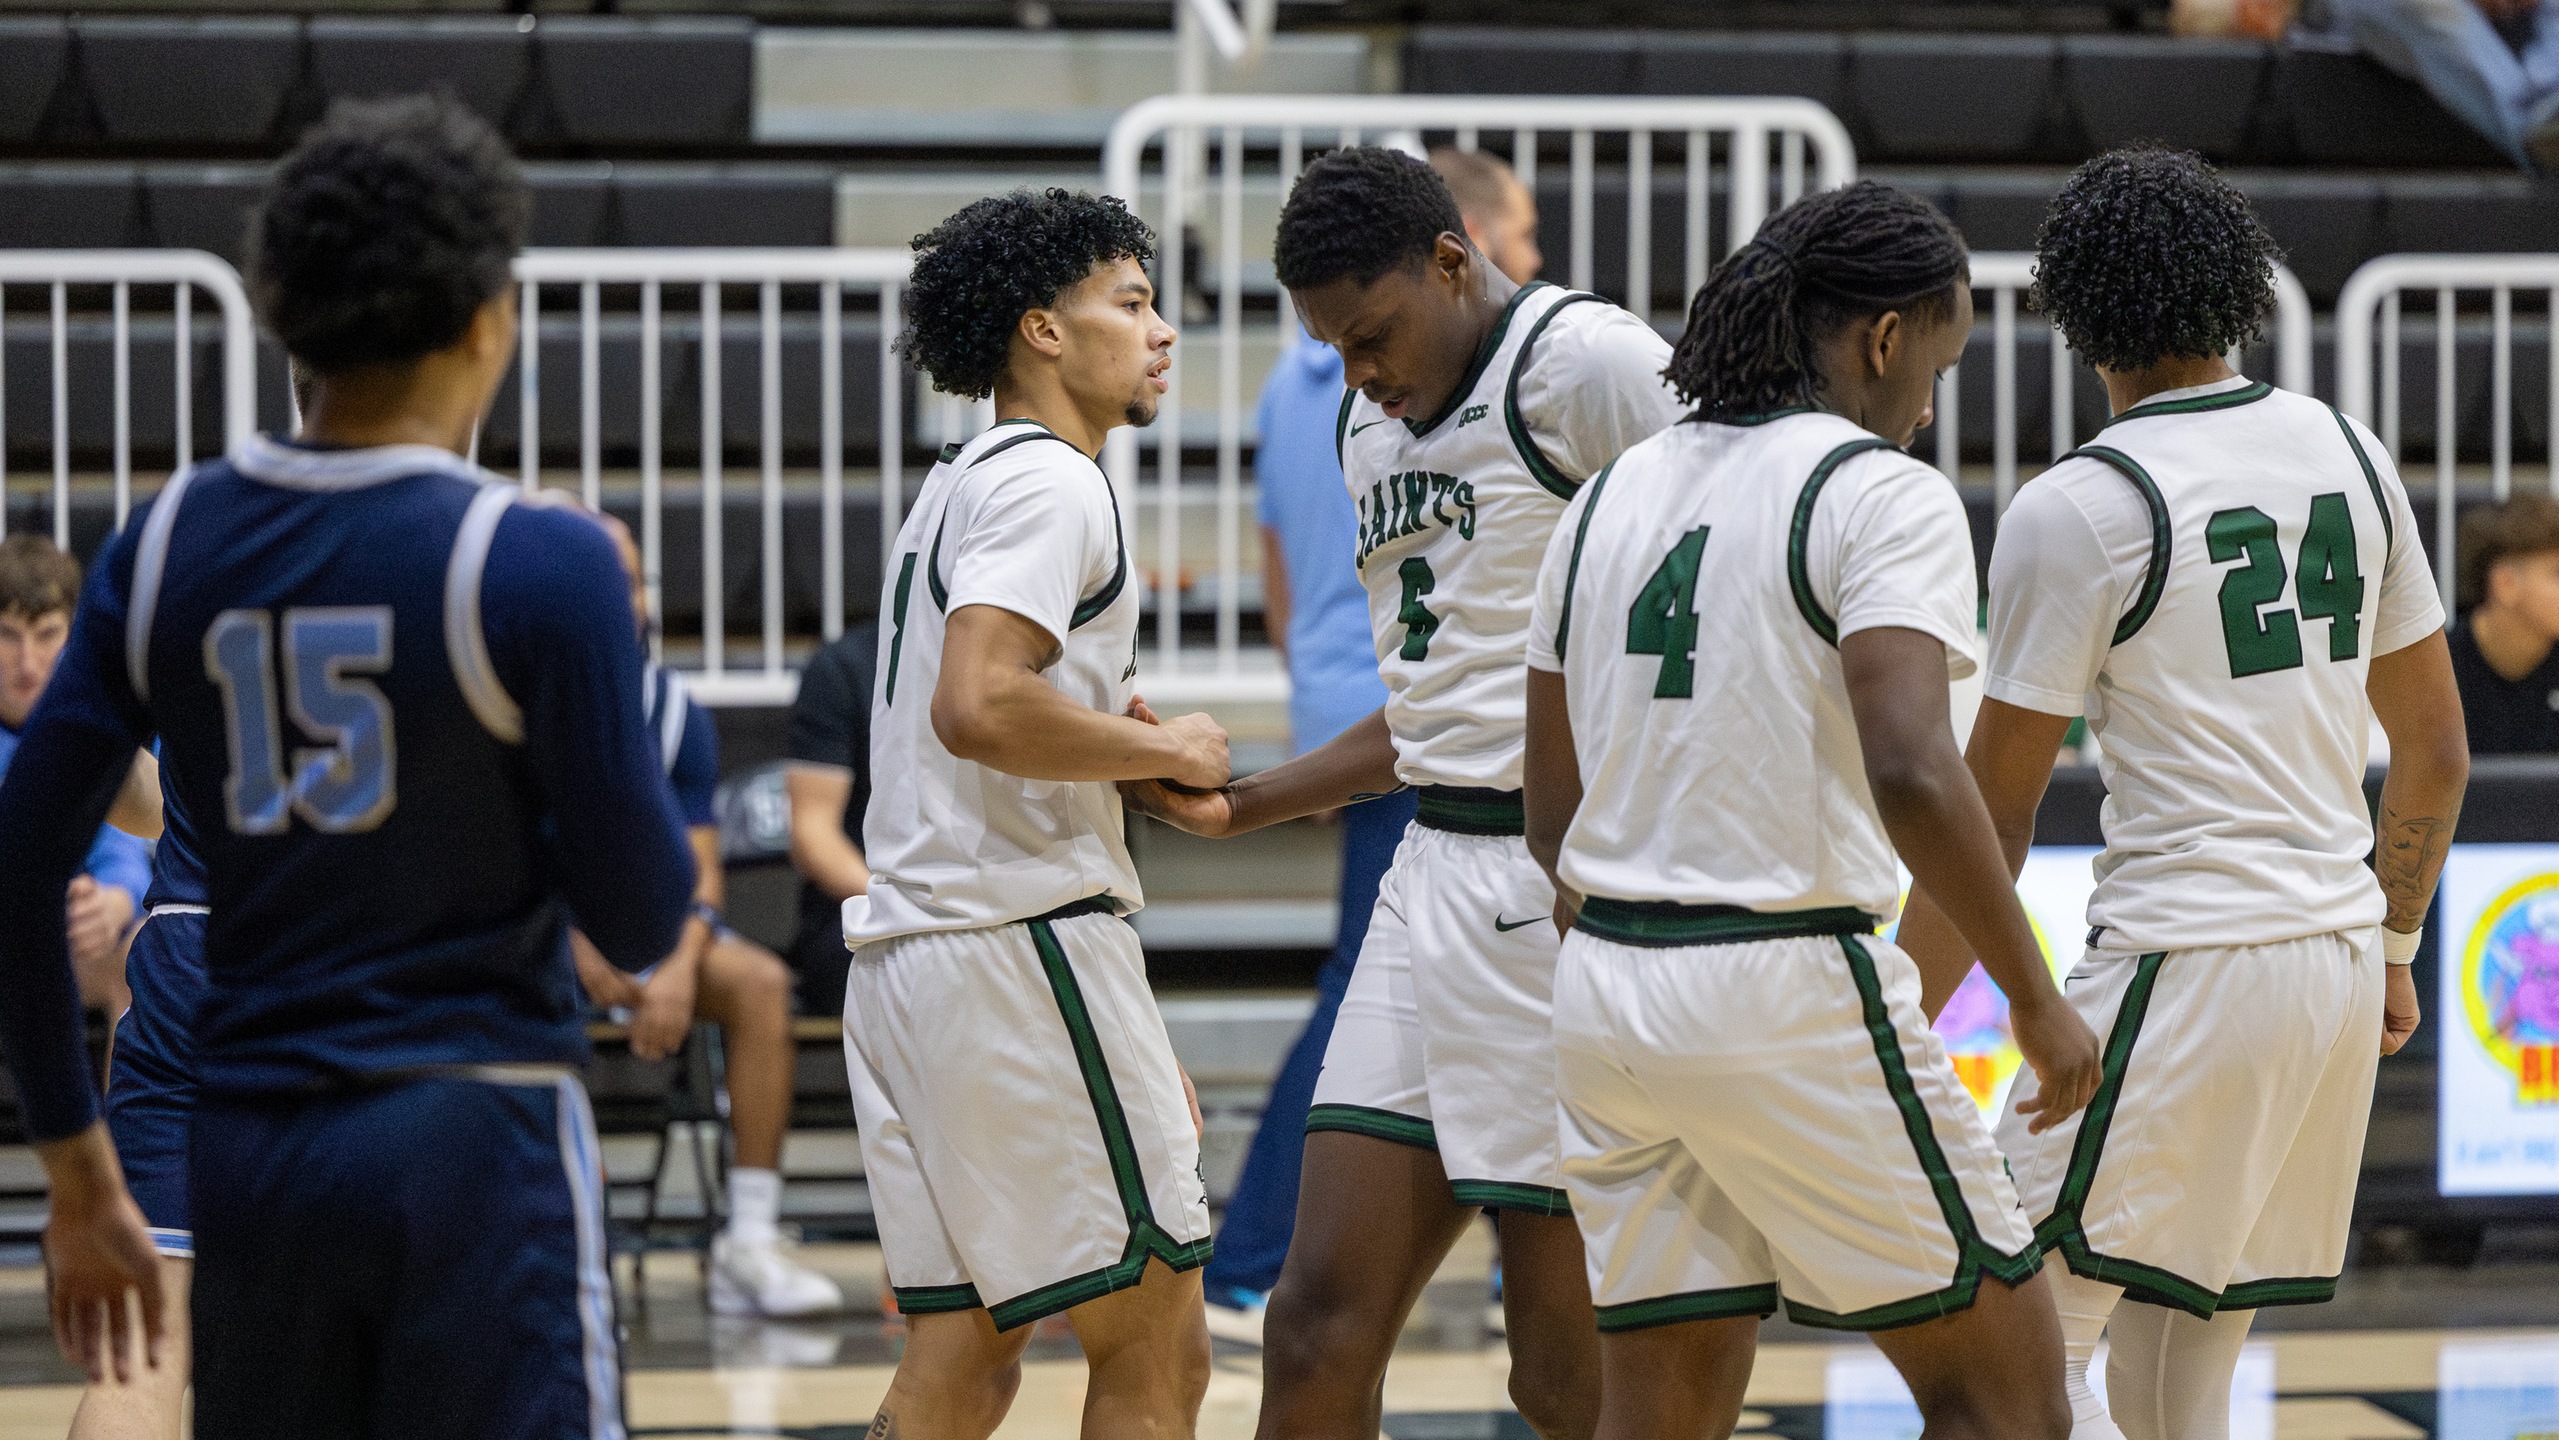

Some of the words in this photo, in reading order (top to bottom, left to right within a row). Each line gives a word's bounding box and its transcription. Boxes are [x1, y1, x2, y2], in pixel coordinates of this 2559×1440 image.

[1397, 556, 1439, 662] 6
[1625, 524, 1711, 699] 4
[2204, 491, 2365, 680] 24
[203, 605, 398, 835] 15
